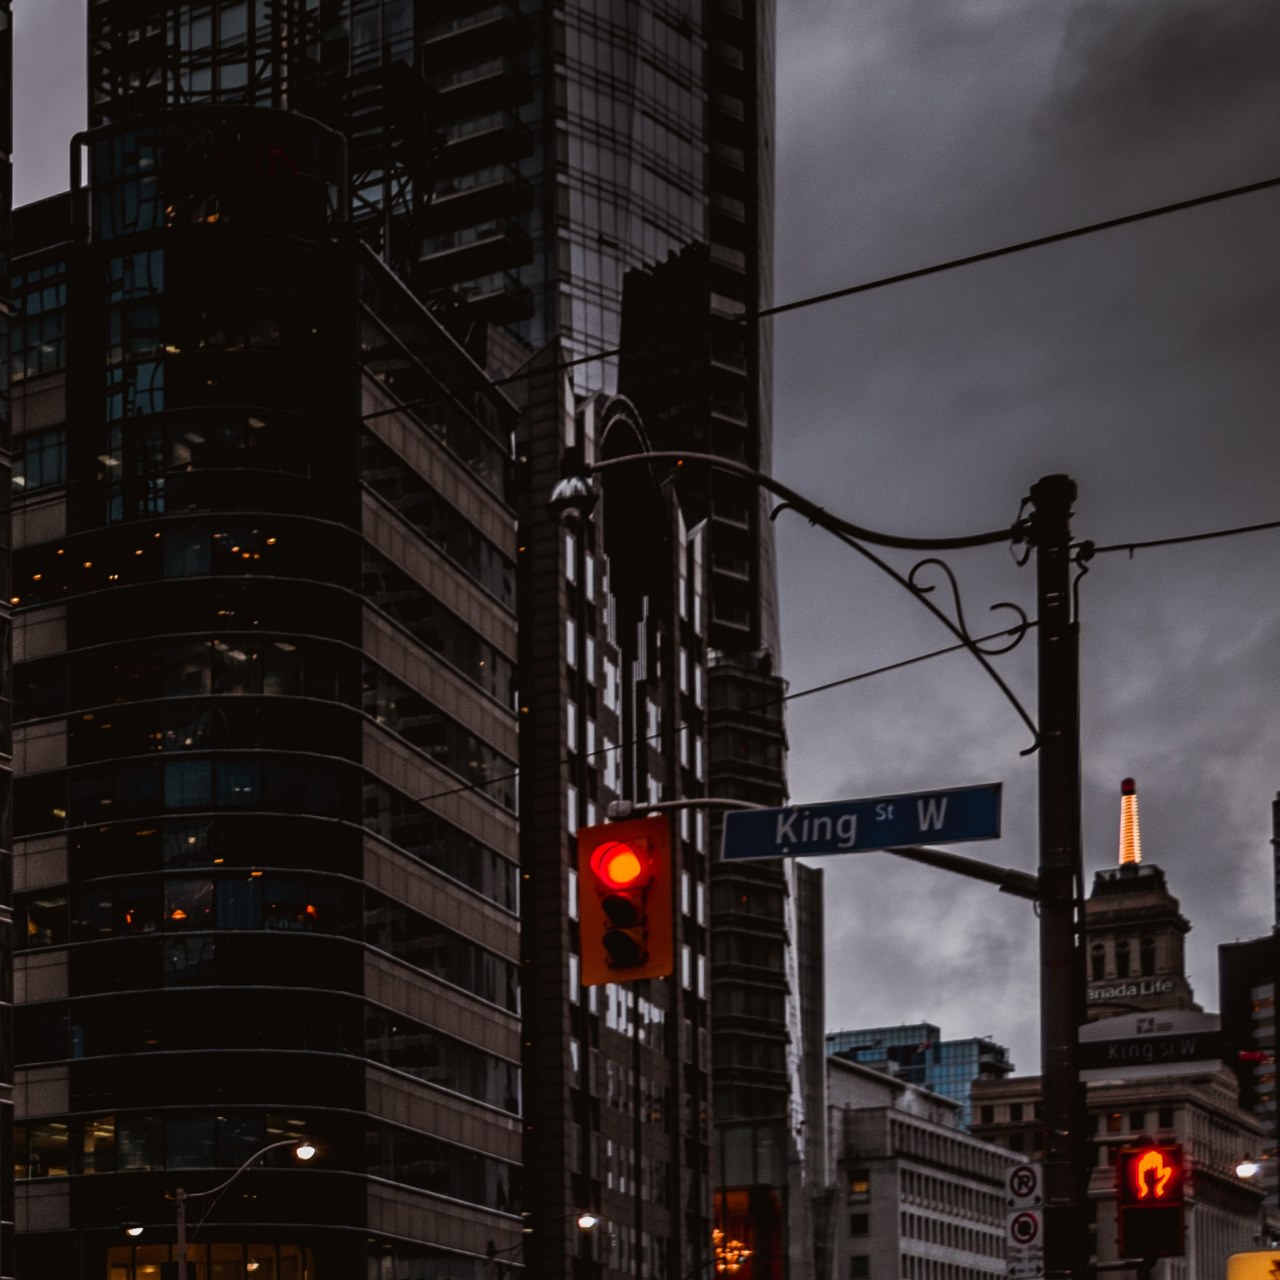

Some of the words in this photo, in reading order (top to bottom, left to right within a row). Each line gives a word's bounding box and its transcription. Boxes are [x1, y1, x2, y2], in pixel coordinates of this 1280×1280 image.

[775, 810, 858, 848] King
[875, 802, 895, 821] St
[917, 796, 948, 832] W
[1087, 983, 1137, 1000] anada
[1140, 979, 1174, 995] Life
[1108, 1042, 1153, 1061] King
[1160, 1042, 1174, 1056] St
[1180, 1037, 1196, 1055] W
